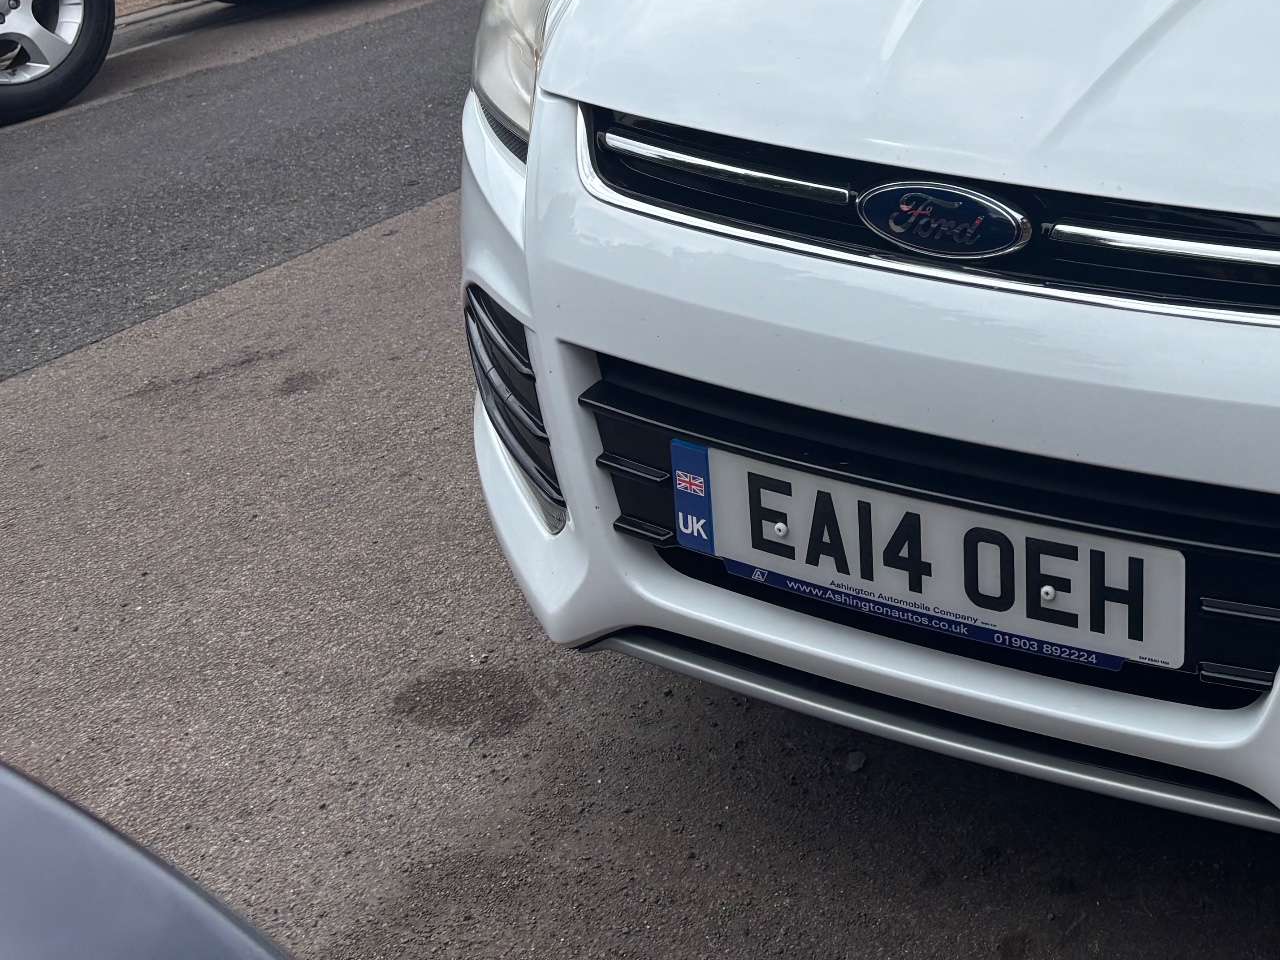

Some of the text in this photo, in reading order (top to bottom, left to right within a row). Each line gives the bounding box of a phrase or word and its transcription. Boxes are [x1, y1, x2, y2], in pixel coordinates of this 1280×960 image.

[888, 192, 985, 246] Ford
[678, 511, 708, 540] UK
[748, 471, 1145, 642] EA14 OEH
[786, 580, 968, 635] www.Ashingtonautos.co.uk
[829, 580, 978, 624] Ashington Automobile Company
[994, 633, 1097, 664] 01903 892224
